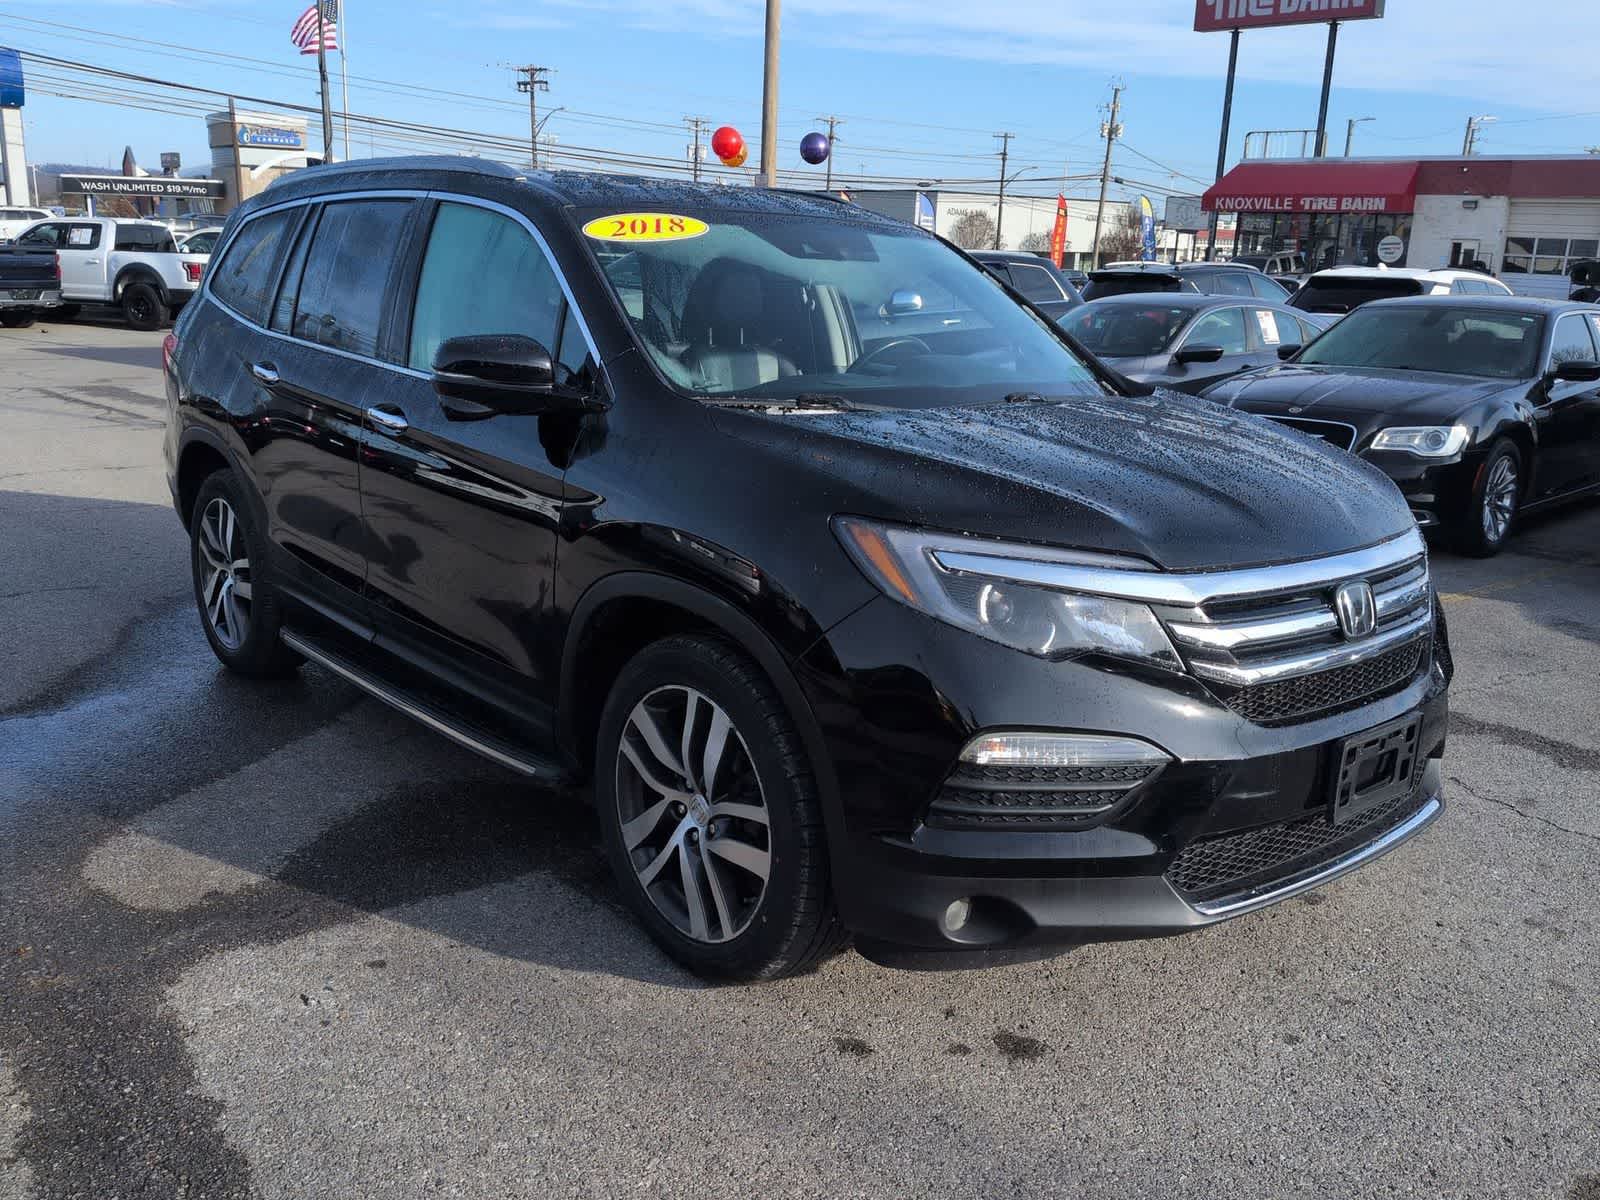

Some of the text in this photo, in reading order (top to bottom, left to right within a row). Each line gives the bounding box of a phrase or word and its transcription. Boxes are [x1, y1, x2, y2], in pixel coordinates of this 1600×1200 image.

[1279, 0, 1365, 14] BA
[80, 181, 110, 191] WASH
[112, 183, 164, 193] UNLIMITED
[1215, 197, 1386, 210] KNOXVILLE TIRE BARN
[611, 218, 685, 237] 2018
